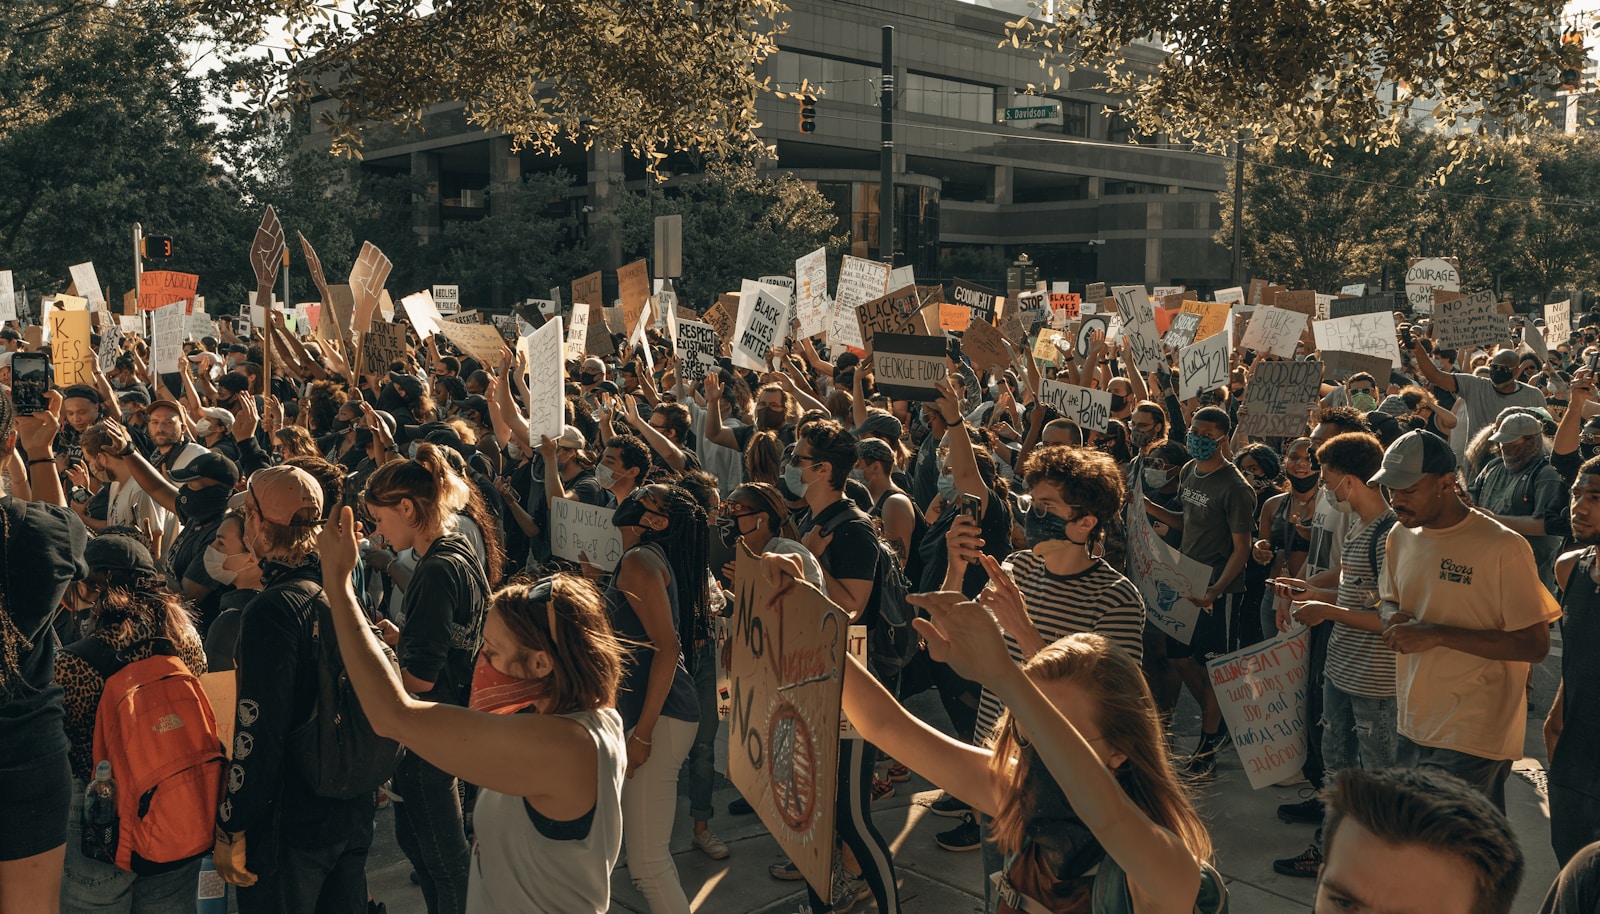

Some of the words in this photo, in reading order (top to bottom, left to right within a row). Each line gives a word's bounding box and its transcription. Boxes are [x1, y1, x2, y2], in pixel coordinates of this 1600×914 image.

[1014, 108, 1046, 118] Davidson
[164, 240, 171, 256] 3
[1408, 267, 1455, 282] COURAGE
[435, 288, 457, 298] ABOLISH
[755, 296, 780, 325] BLACK
[859, 297, 899, 324] BLACK
[1020, 295, 1044, 311] STOP
[1183, 303, 1210, 314] BLACK
[1443, 300, 1462, 313] NO
[1552, 303, 1564, 312] NO
[574, 314, 587, 326] LOVE
[705, 311, 727, 338] MATTER
[750, 317, 773, 342] LIVES
[864, 314, 901, 342] LIVES
[1263, 311, 1291, 336] FUCK
[1325, 315, 1386, 337] BLACK
[1553, 323, 1564, 332] NO
[378, 334, 386, 347] TO
[389, 336, 398, 348] BE
[679, 323, 714, 343] RESPECT
[1261, 329, 1281, 345] 45
[1547, 330, 1568, 343] PEACE
[52, 340, 81, 360] VES
[384, 348, 393, 361] TO
[677, 338, 714, 356] EXISTANCE
[741, 330, 772, 361] MATTER
[686, 350, 699, 361] OR
[53, 360, 86, 385] TER
[681, 359, 711, 374] EXPECT
[878, 356, 915, 380] GEORGE
[917, 359, 946, 382] FLOYD
[1255, 362, 1288, 385] GOOD
[1290, 362, 1322, 384] COPS
[1266, 401, 1288, 414] THE
[1238, 414, 1267, 434] BAD
[556, 501, 568, 520] NO
[572, 506, 608, 530] Justice
[573, 533, 598, 560] Peace!
[1440, 558, 1473, 575] Coors
[730, 576, 763, 661] No
[1242, 703, 1262, 723] ass
[731, 675, 763, 771] No
